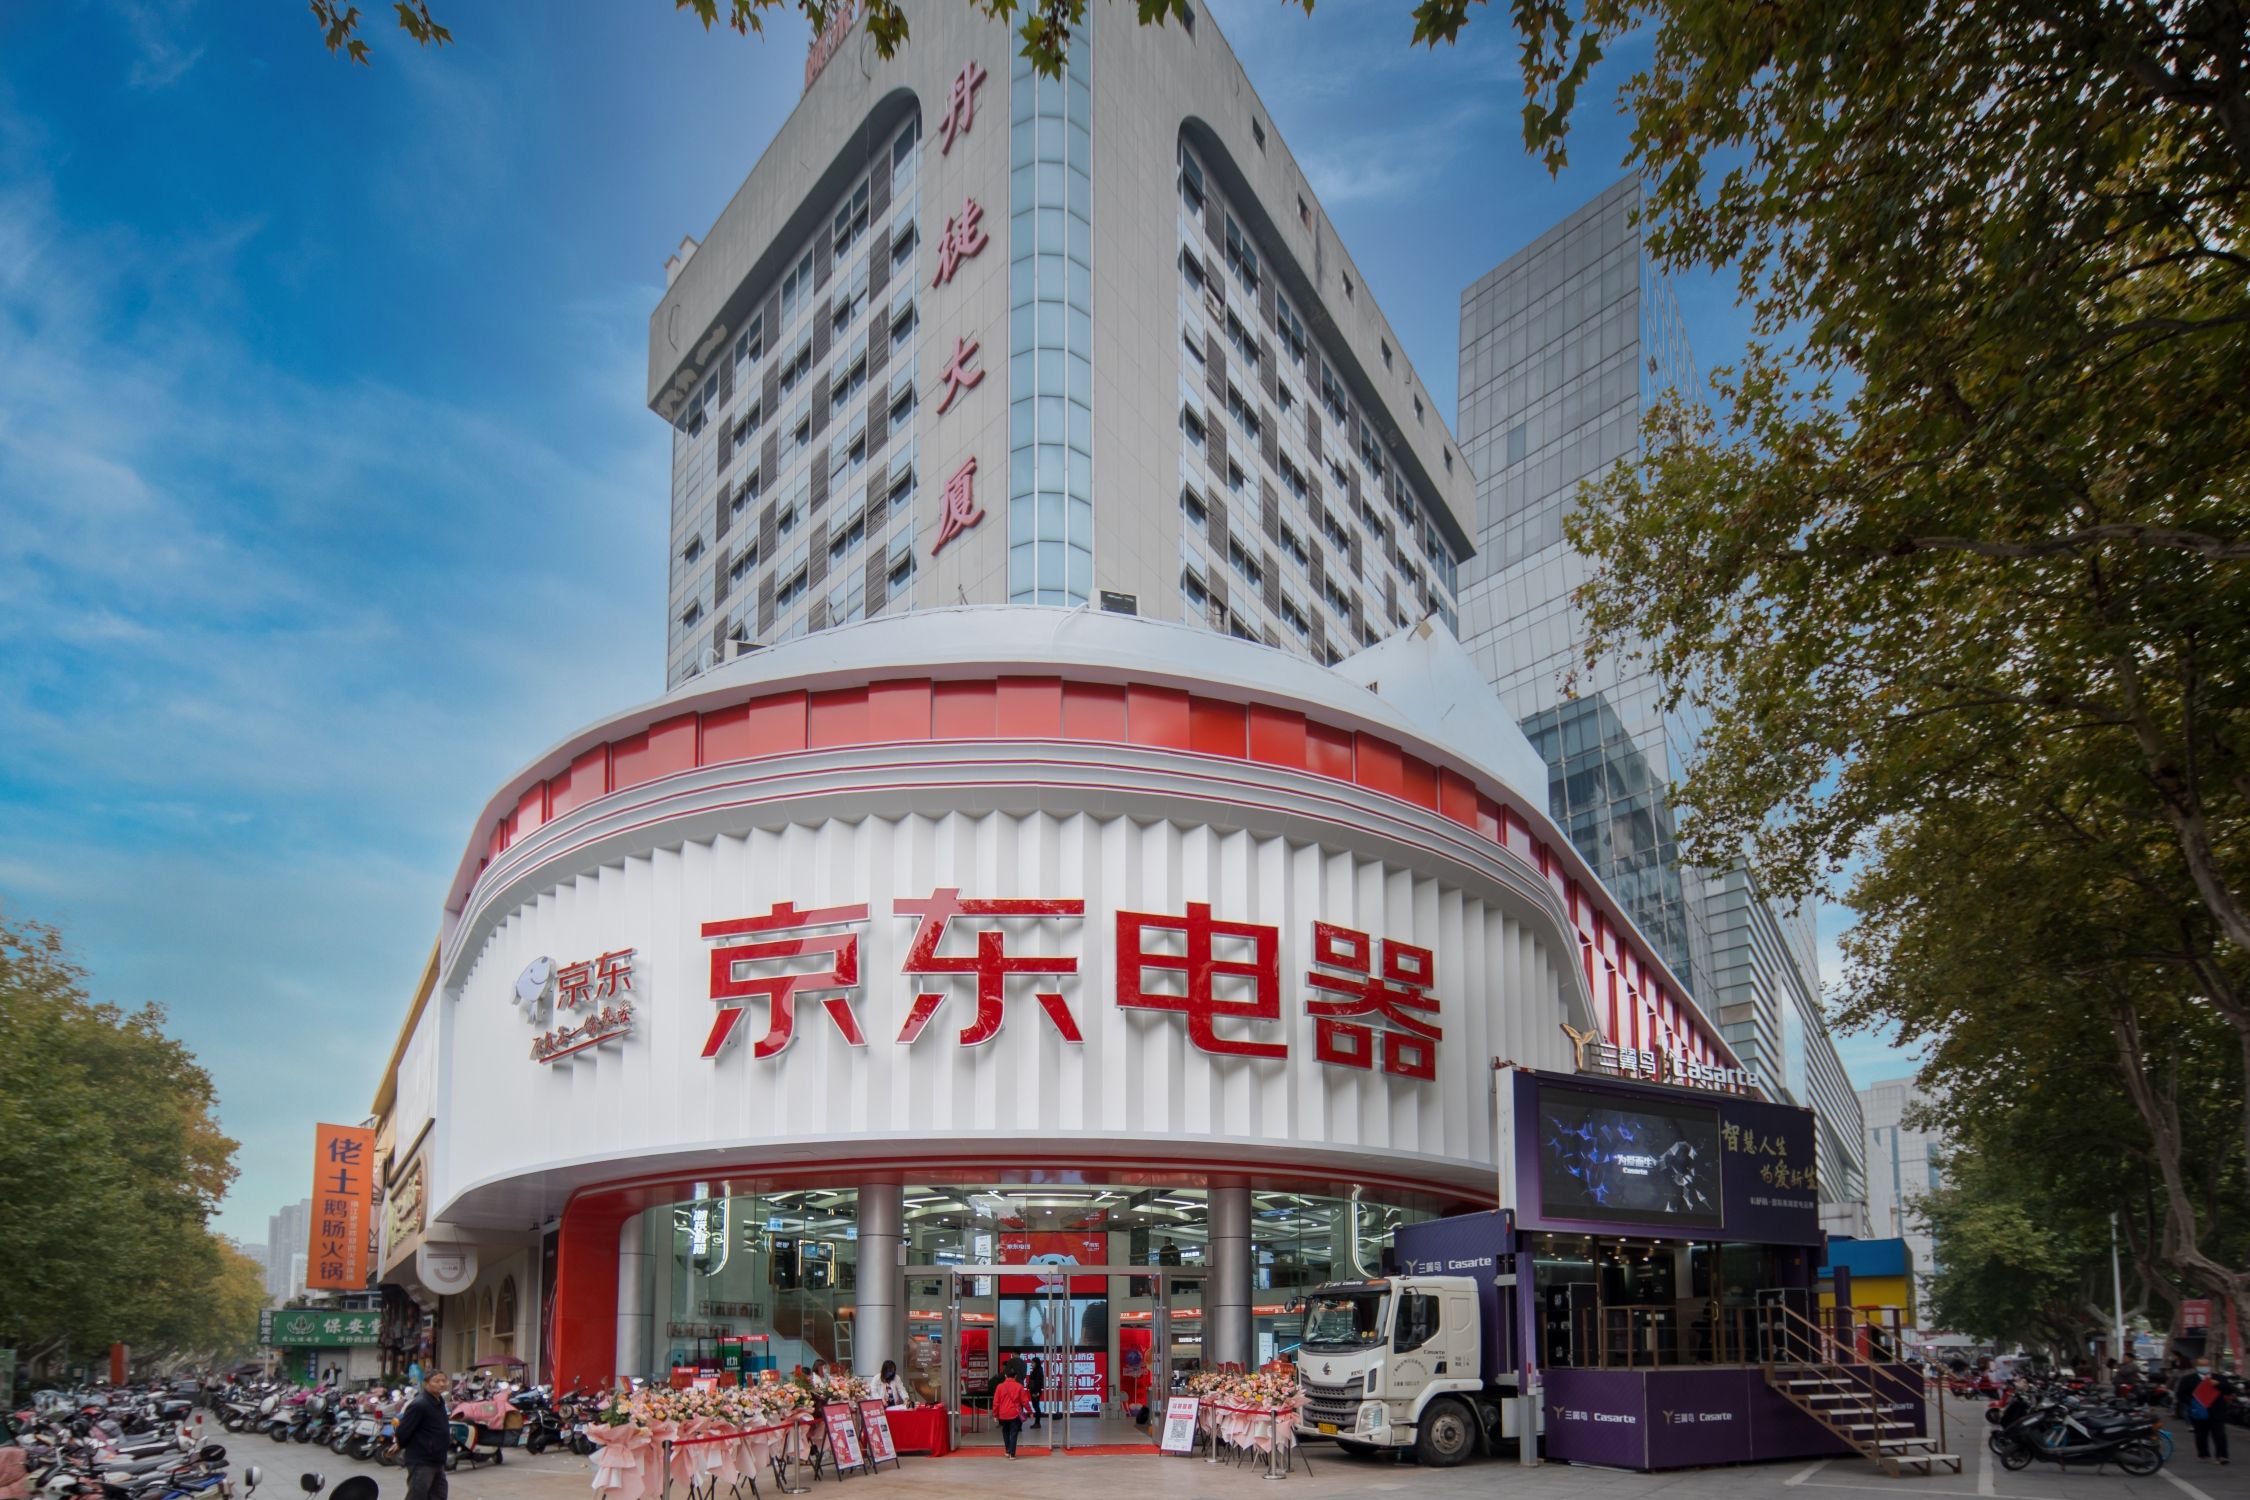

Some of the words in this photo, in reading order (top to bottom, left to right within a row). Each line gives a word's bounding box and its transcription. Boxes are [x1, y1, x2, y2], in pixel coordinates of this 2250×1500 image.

[932, 60, 989, 556] 丹徒大厦
[557, 947, 635, 1009] 京东
[700, 887, 1443, 1082] 京东电器
[1600, 1042, 1656, 1075] 三翼鸟
[1673, 1056, 1760, 1086] Casarte
[1721, 1120, 1788, 1156] 智慧人生
[1419, 1262, 1442, 1274] 三翼鸟
[1448, 1257, 1492, 1270] Casarte
[1565, 1410, 1588, 1421] 三翼鸟
[1594, 1412, 1636, 1424] Casarte
[1699, 1412, 1732, 1422] Casarte
